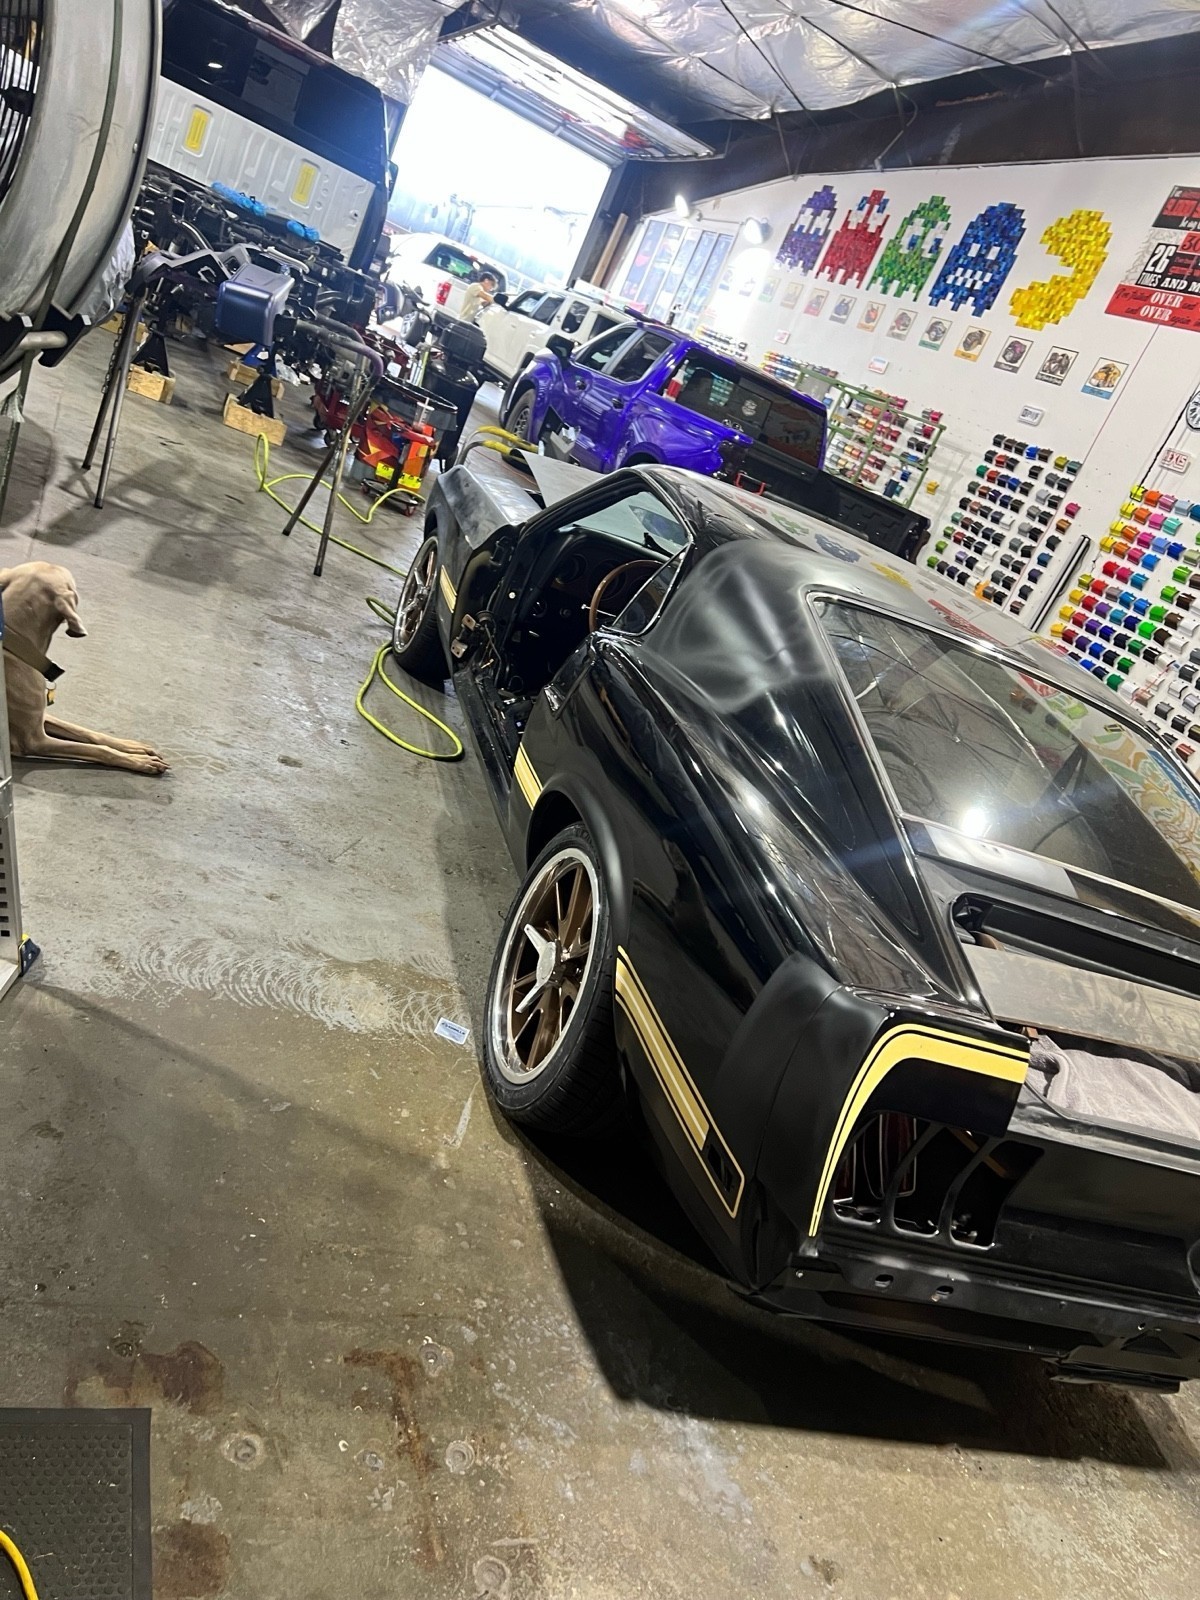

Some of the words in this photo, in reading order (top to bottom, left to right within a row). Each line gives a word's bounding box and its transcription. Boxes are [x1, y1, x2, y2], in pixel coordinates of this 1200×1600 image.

[1145, 244, 1177, 274] 26
[1137, 272, 1162, 287] TIMES
[1160, 277, 1188, 290] AND
[1150, 291, 1184, 308] OVER
[1140, 304, 1173, 321] OVER
